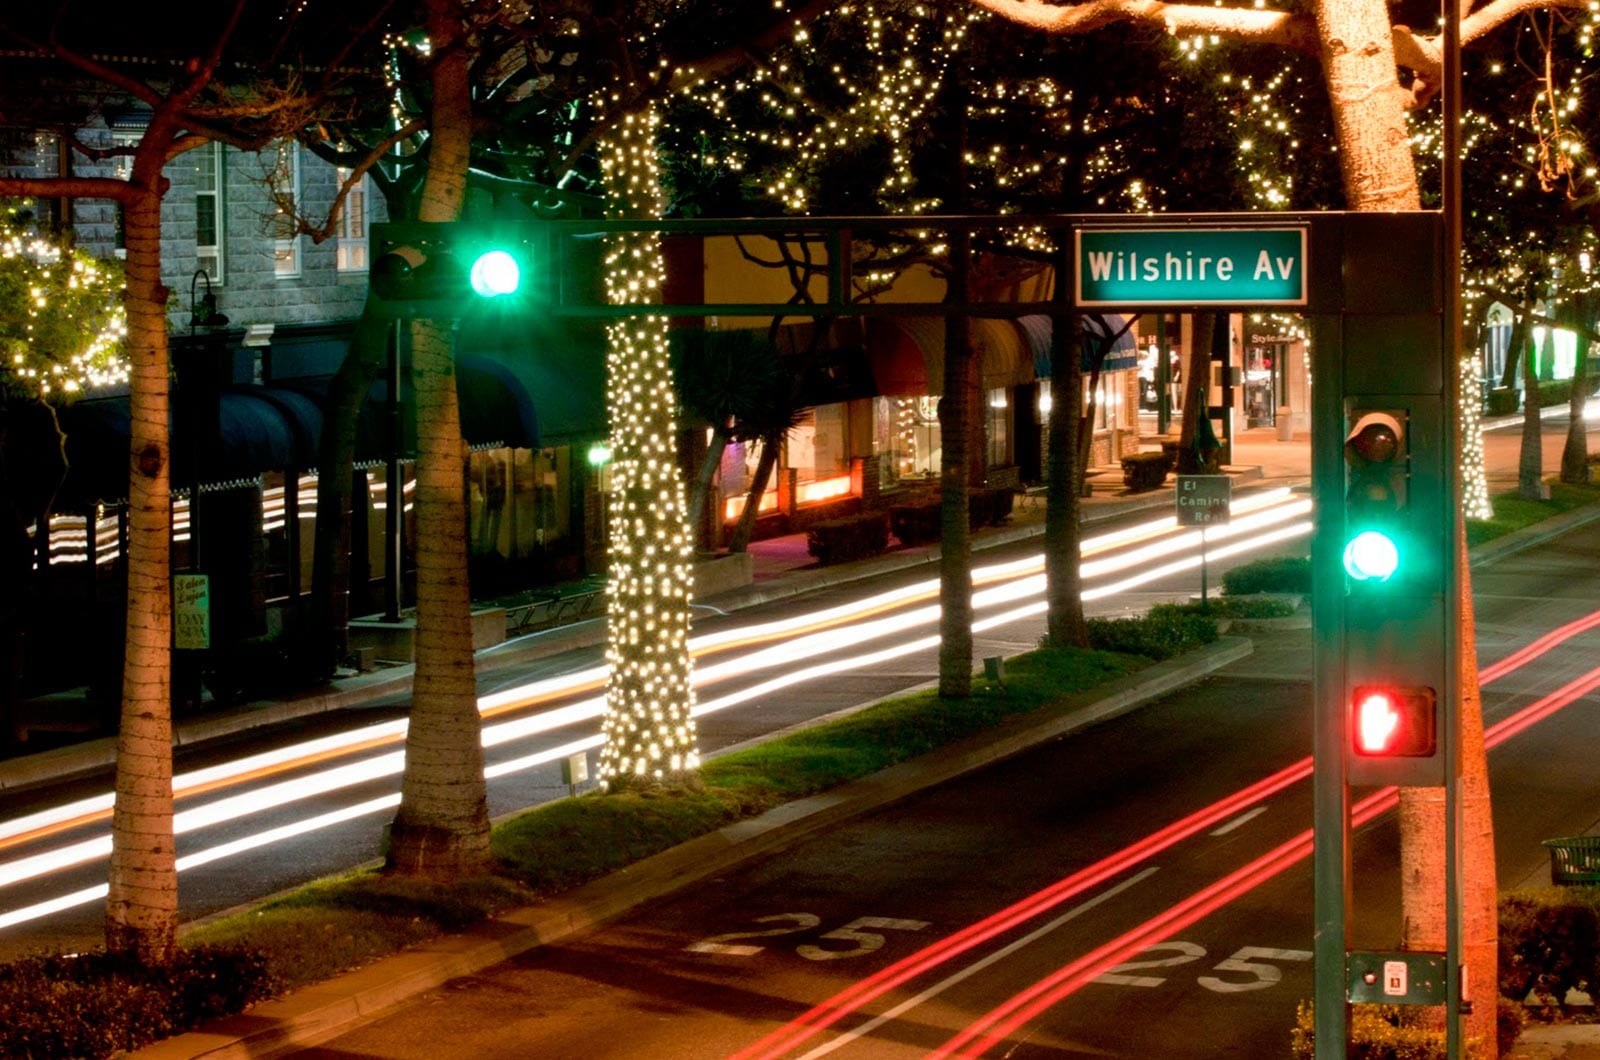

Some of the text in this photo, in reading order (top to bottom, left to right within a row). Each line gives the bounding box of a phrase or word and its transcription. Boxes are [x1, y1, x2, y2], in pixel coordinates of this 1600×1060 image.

[1088, 250, 1294, 281] Wilshire Av
[1184, 481, 1196, 490] El
[1180, 496, 1227, 506] Camino
[177, 613, 206, 625] DAY
[685, 912, 931, 961] 25
[1096, 940, 1313, 993] 25
